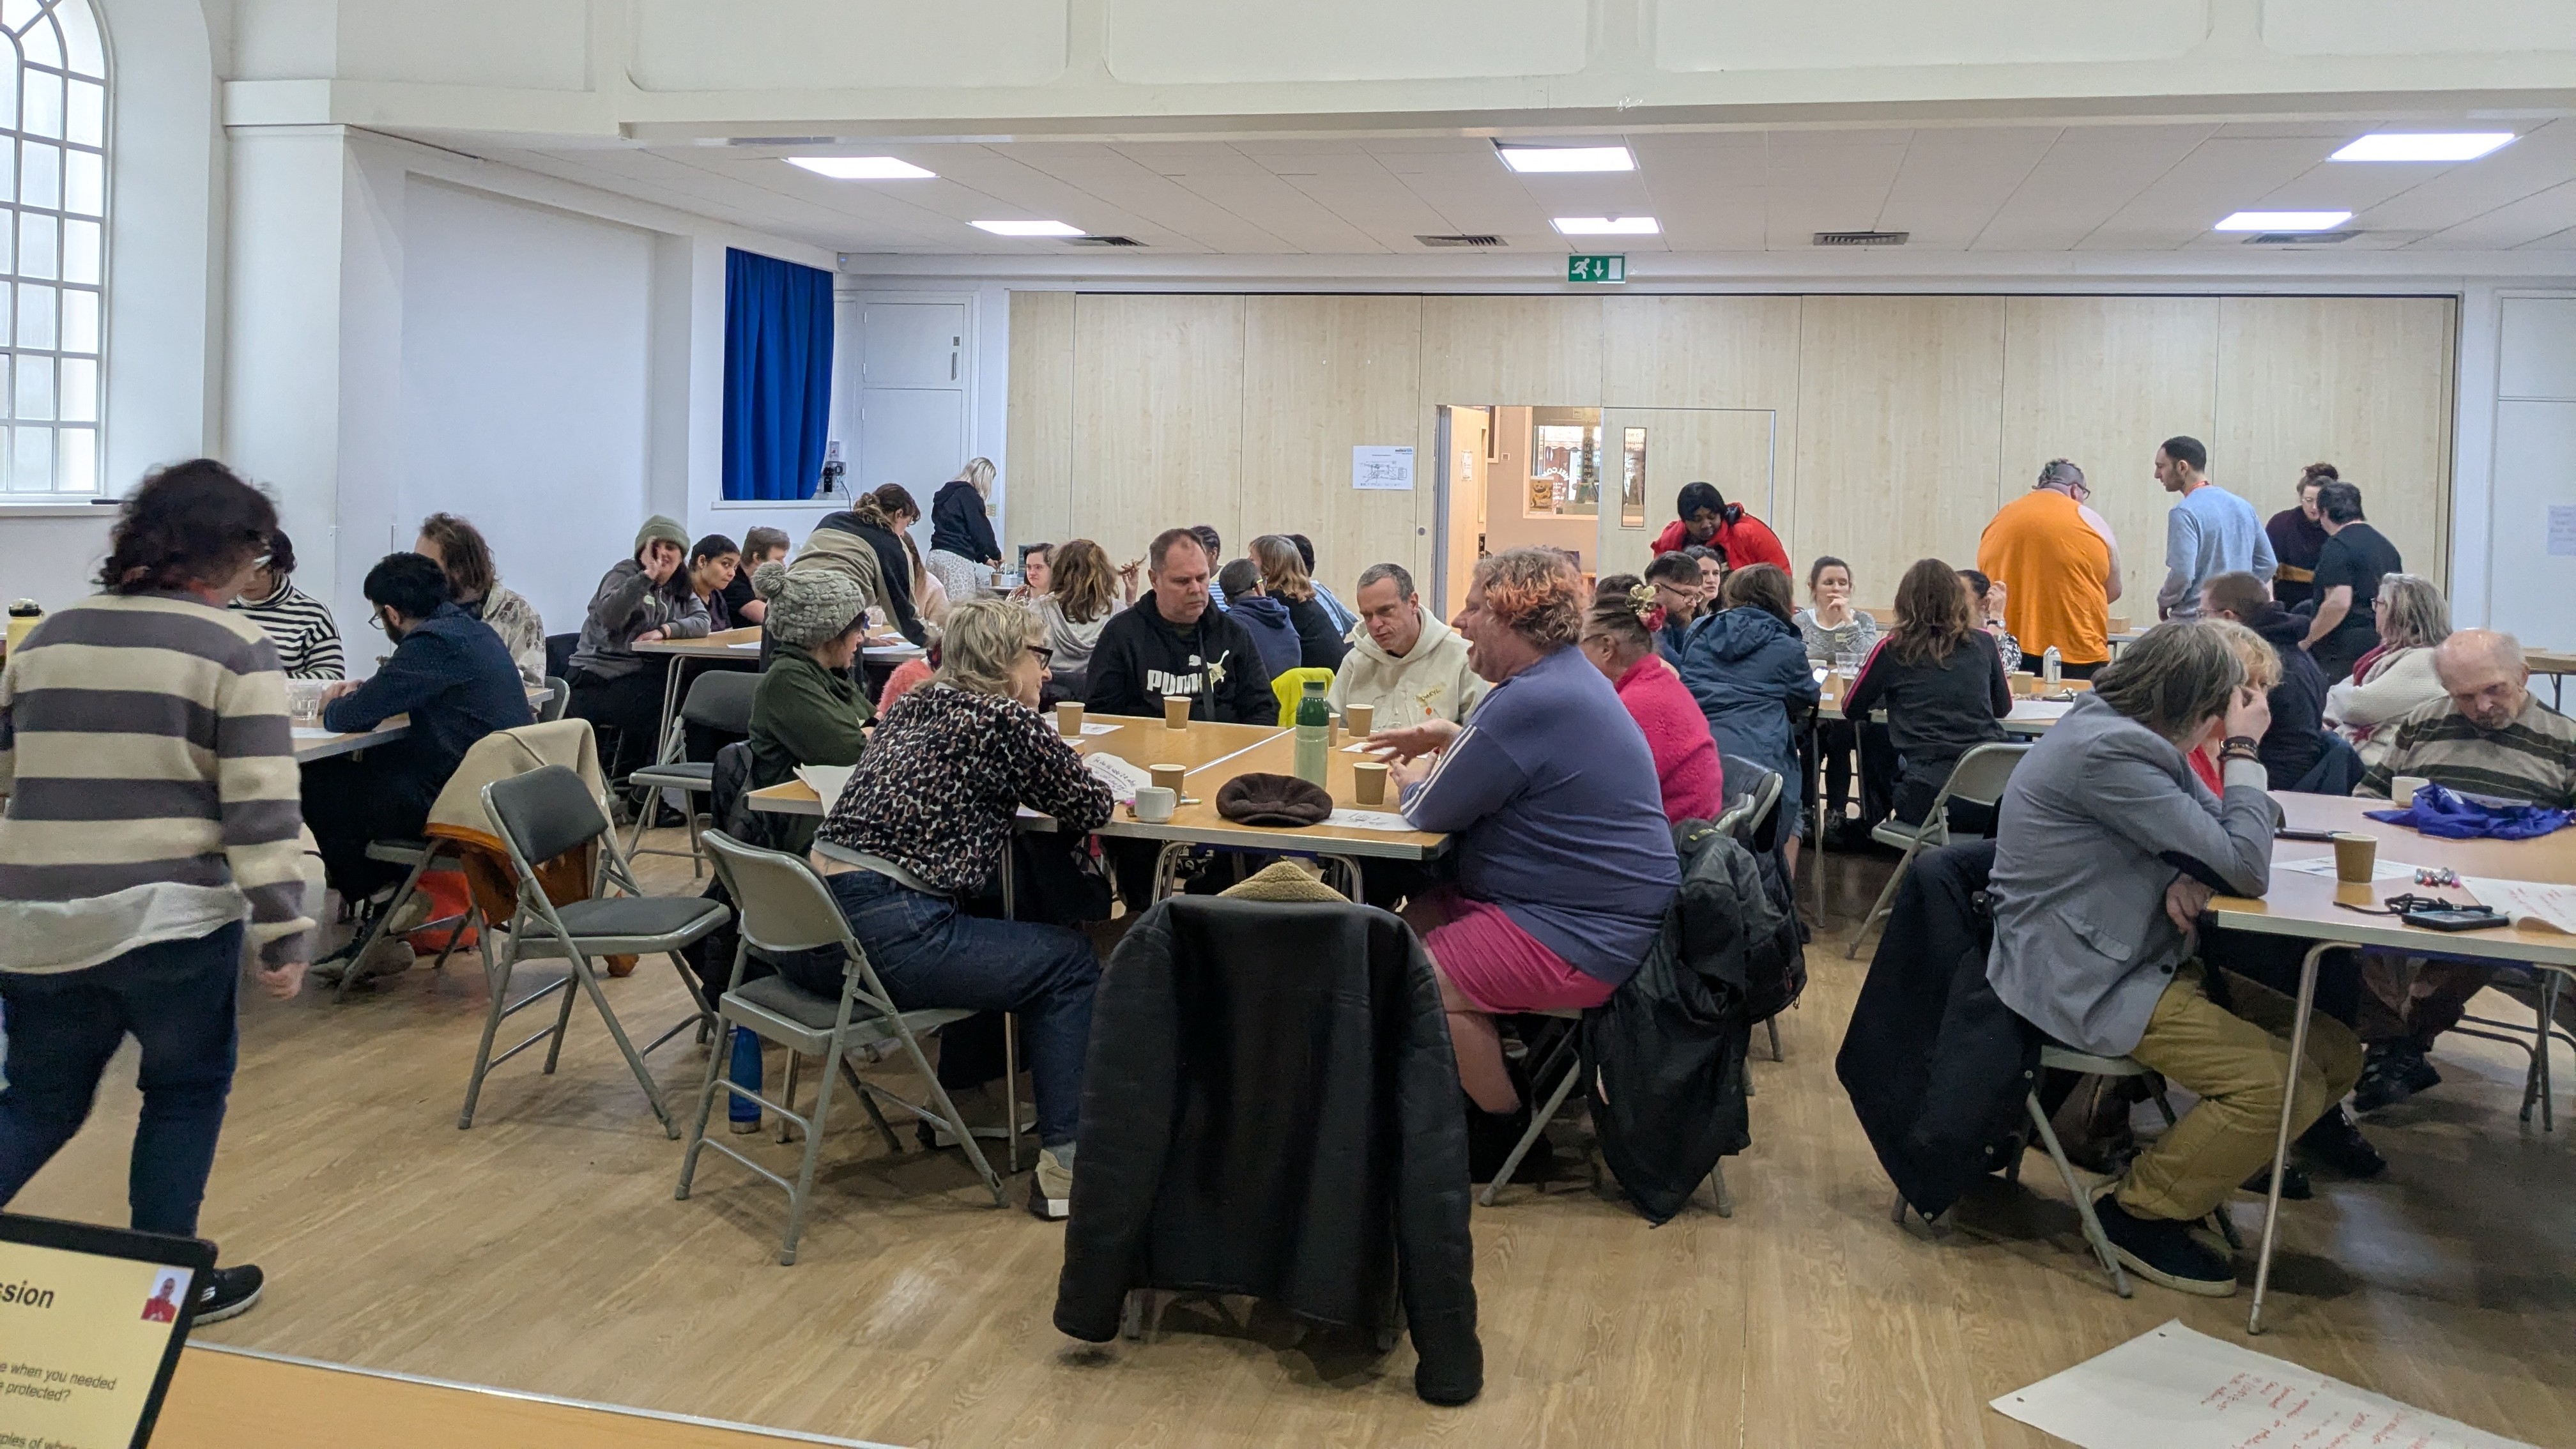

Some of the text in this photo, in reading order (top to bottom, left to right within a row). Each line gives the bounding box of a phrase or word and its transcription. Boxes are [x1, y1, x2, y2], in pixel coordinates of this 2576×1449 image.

[0, 1280, 54, 1309] sion
[11, 1362, 42, 1377] when
[43, 1370, 67, 1383] you
[70, 1374, 117, 1390] needed
[5, 1383, 71, 1402] protected?
